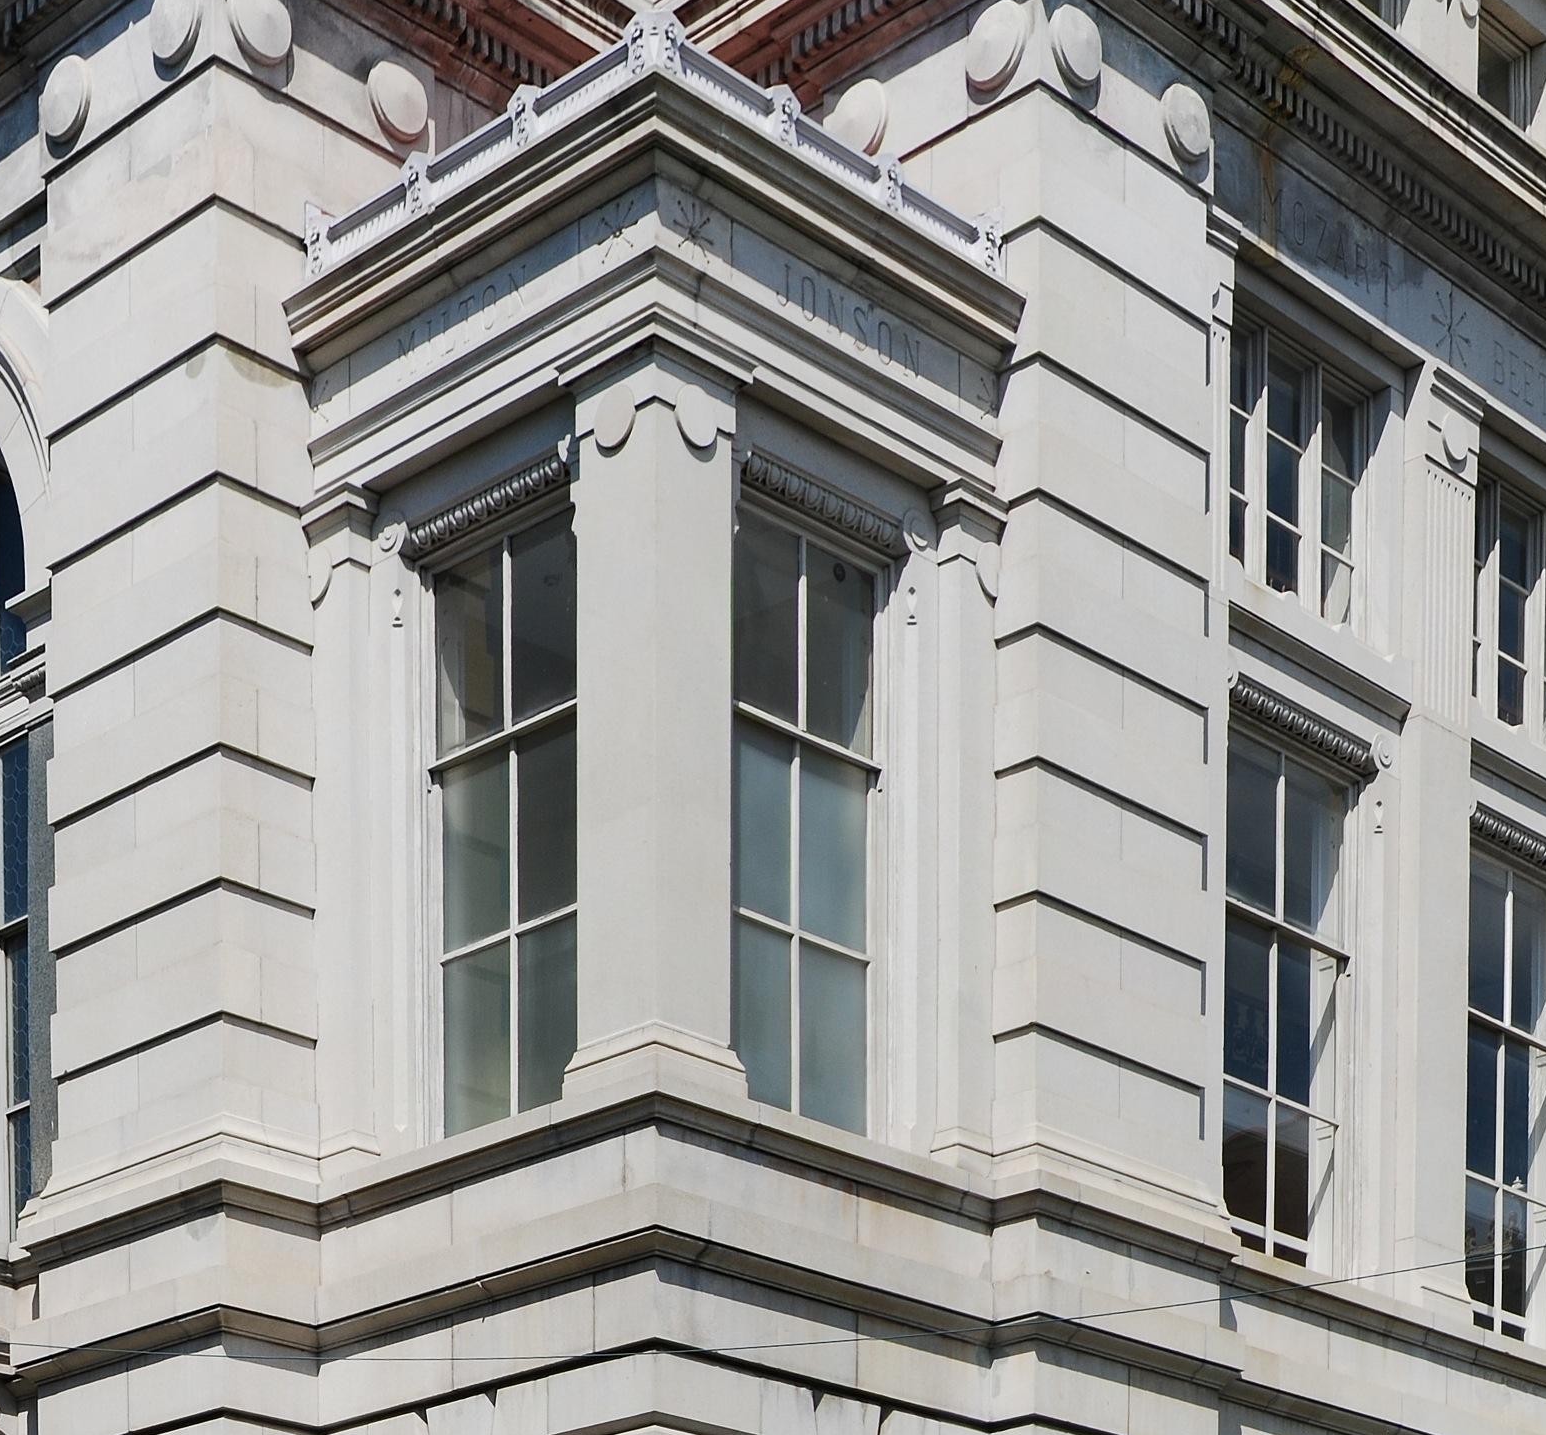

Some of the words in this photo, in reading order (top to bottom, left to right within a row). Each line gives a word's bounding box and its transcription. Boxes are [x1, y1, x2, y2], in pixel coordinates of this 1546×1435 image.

[1260, 175, 1392, 309] MOZART
[396, 264, 527, 382] MILTON
[775, 264, 922, 382] JONSON
